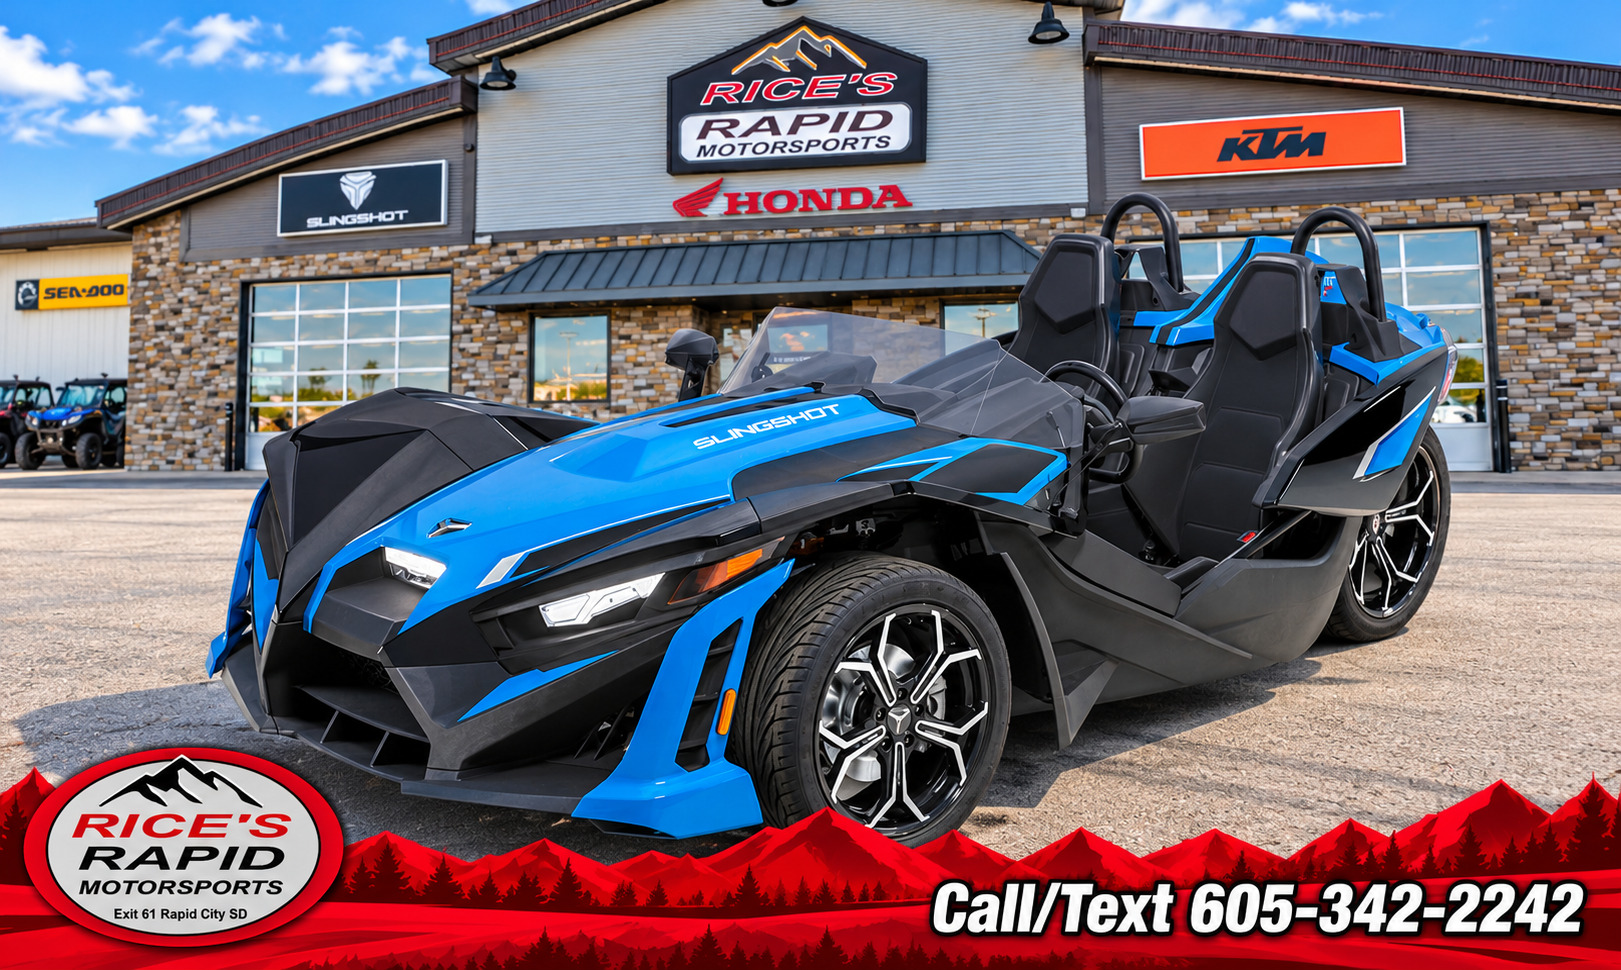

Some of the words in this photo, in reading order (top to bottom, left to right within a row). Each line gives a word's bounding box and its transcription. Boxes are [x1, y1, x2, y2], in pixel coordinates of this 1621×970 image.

[700, 72, 898, 105] RICE'S
[696, 110, 894, 140] RAPID
[696, 135, 891, 158] MOTORSPORTS
[1217, 126, 1327, 162] KTM
[723, 184, 913, 216] HONDA
[306, 209, 409, 228] SLINGSHOT
[693, 403, 839, 449] SLINGSHOT
